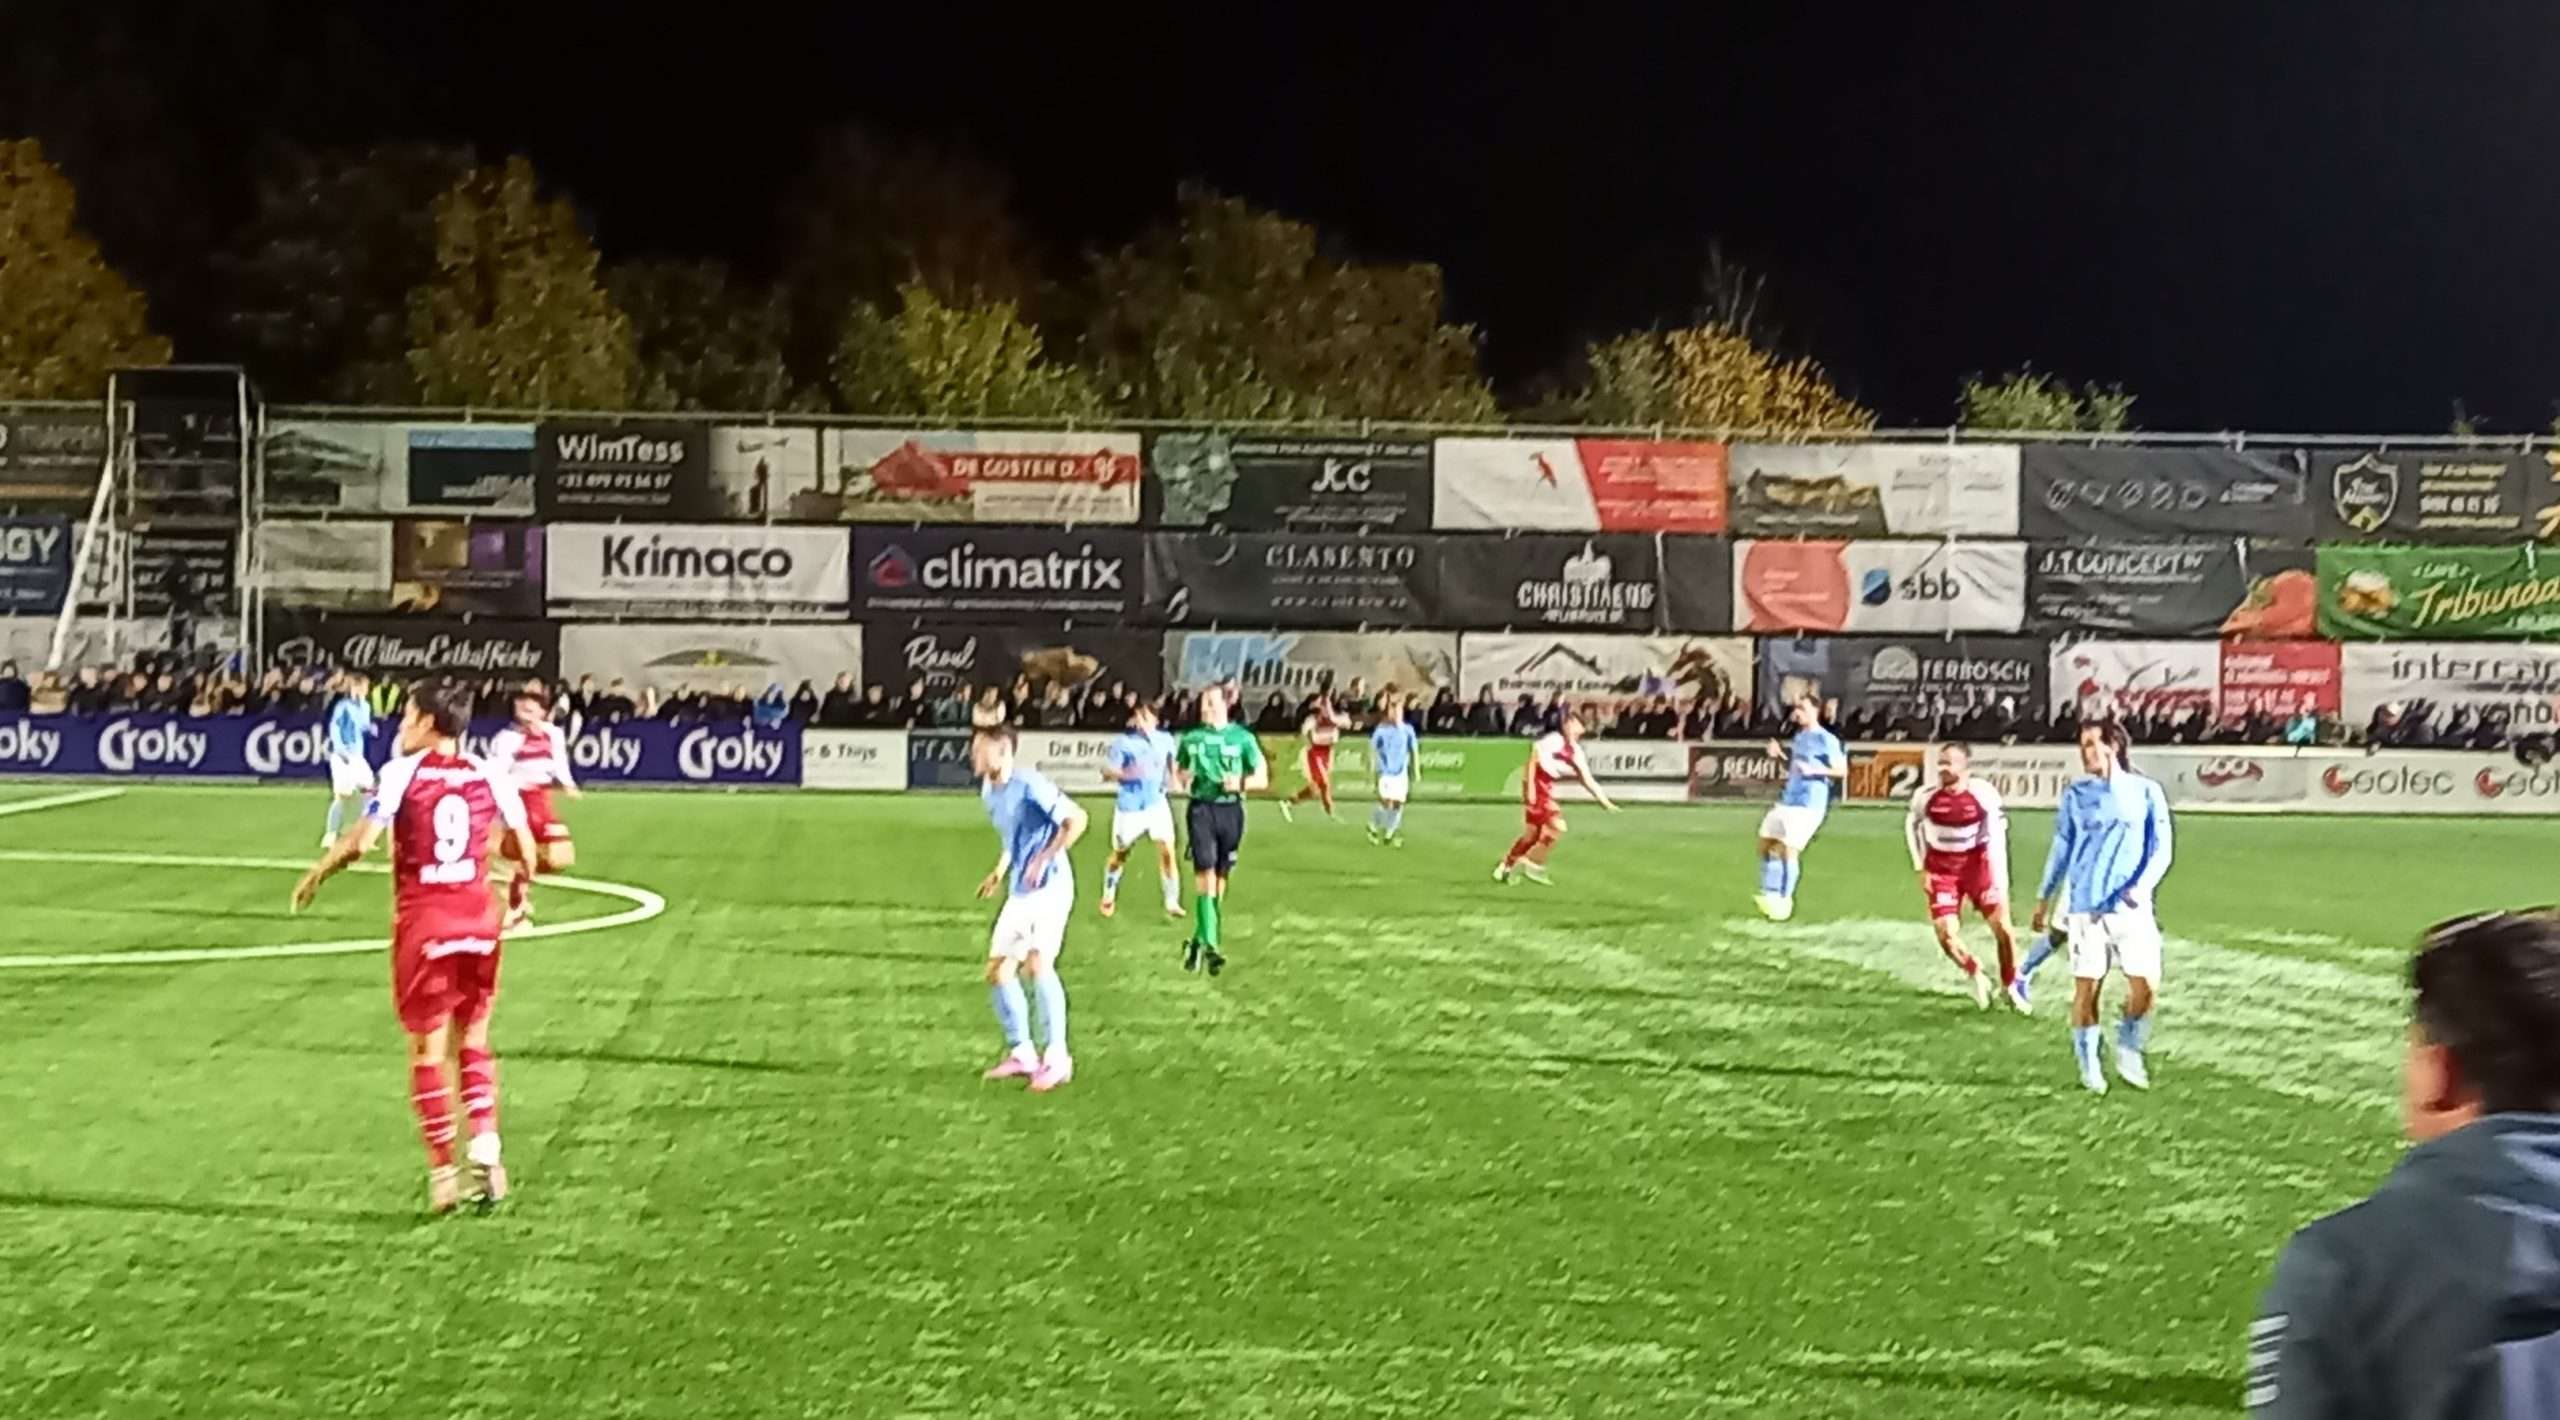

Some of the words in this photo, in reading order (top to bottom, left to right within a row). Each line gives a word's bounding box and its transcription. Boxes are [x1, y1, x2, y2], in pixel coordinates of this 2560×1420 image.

[602, 534, 793, 578] Krimaco
[922, 543, 1123, 590] climatrix
[1901, 569, 1961, 600] sbb
[98, 718, 208, 770] Croky
[245, 721, 331, 773] Crok
[573, 727, 642, 775] oky
[679, 726, 783, 779] Croky
[2322, 764, 2453, 797] Geotec
[433, 793, 480, 863] 9
